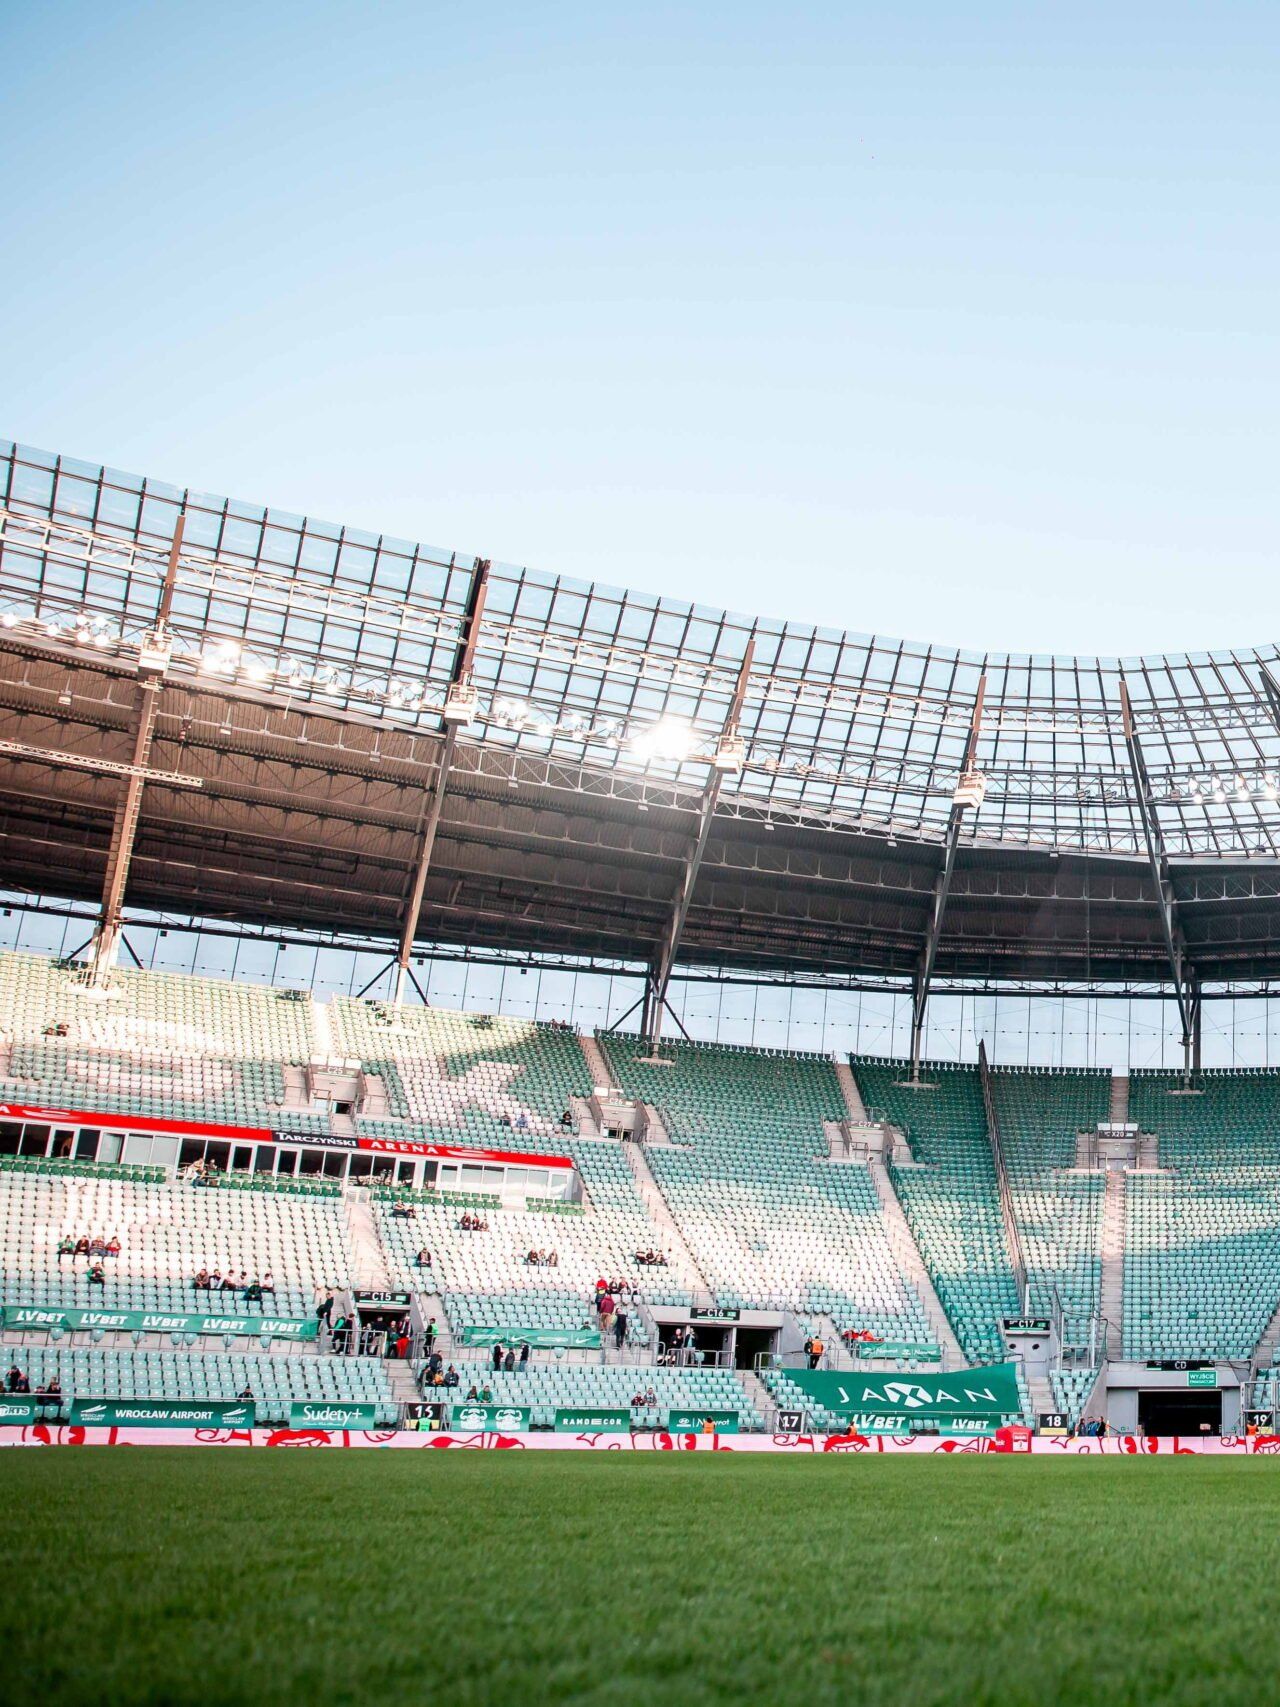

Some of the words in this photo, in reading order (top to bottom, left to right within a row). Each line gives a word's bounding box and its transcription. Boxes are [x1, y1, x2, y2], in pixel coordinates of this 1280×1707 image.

[328, 1066, 343, 1074] C25
[276, 1132, 357, 1147] TARCZYŃSKI
[371, 1141, 439, 1154] ARENA
[371, 1291, 392, 1301] C15
[707, 1308, 724, 1317] C16
[1018, 1320, 1035, 1328] C17
[1174, 1361, 1187, 1370] CD
[170, 1410, 214, 1420] AIRPORT
[782, 1415, 799, 1428] 17
[1046, 1415, 1061, 1427] 18
[1253, 1414, 1267, 1427] 19
